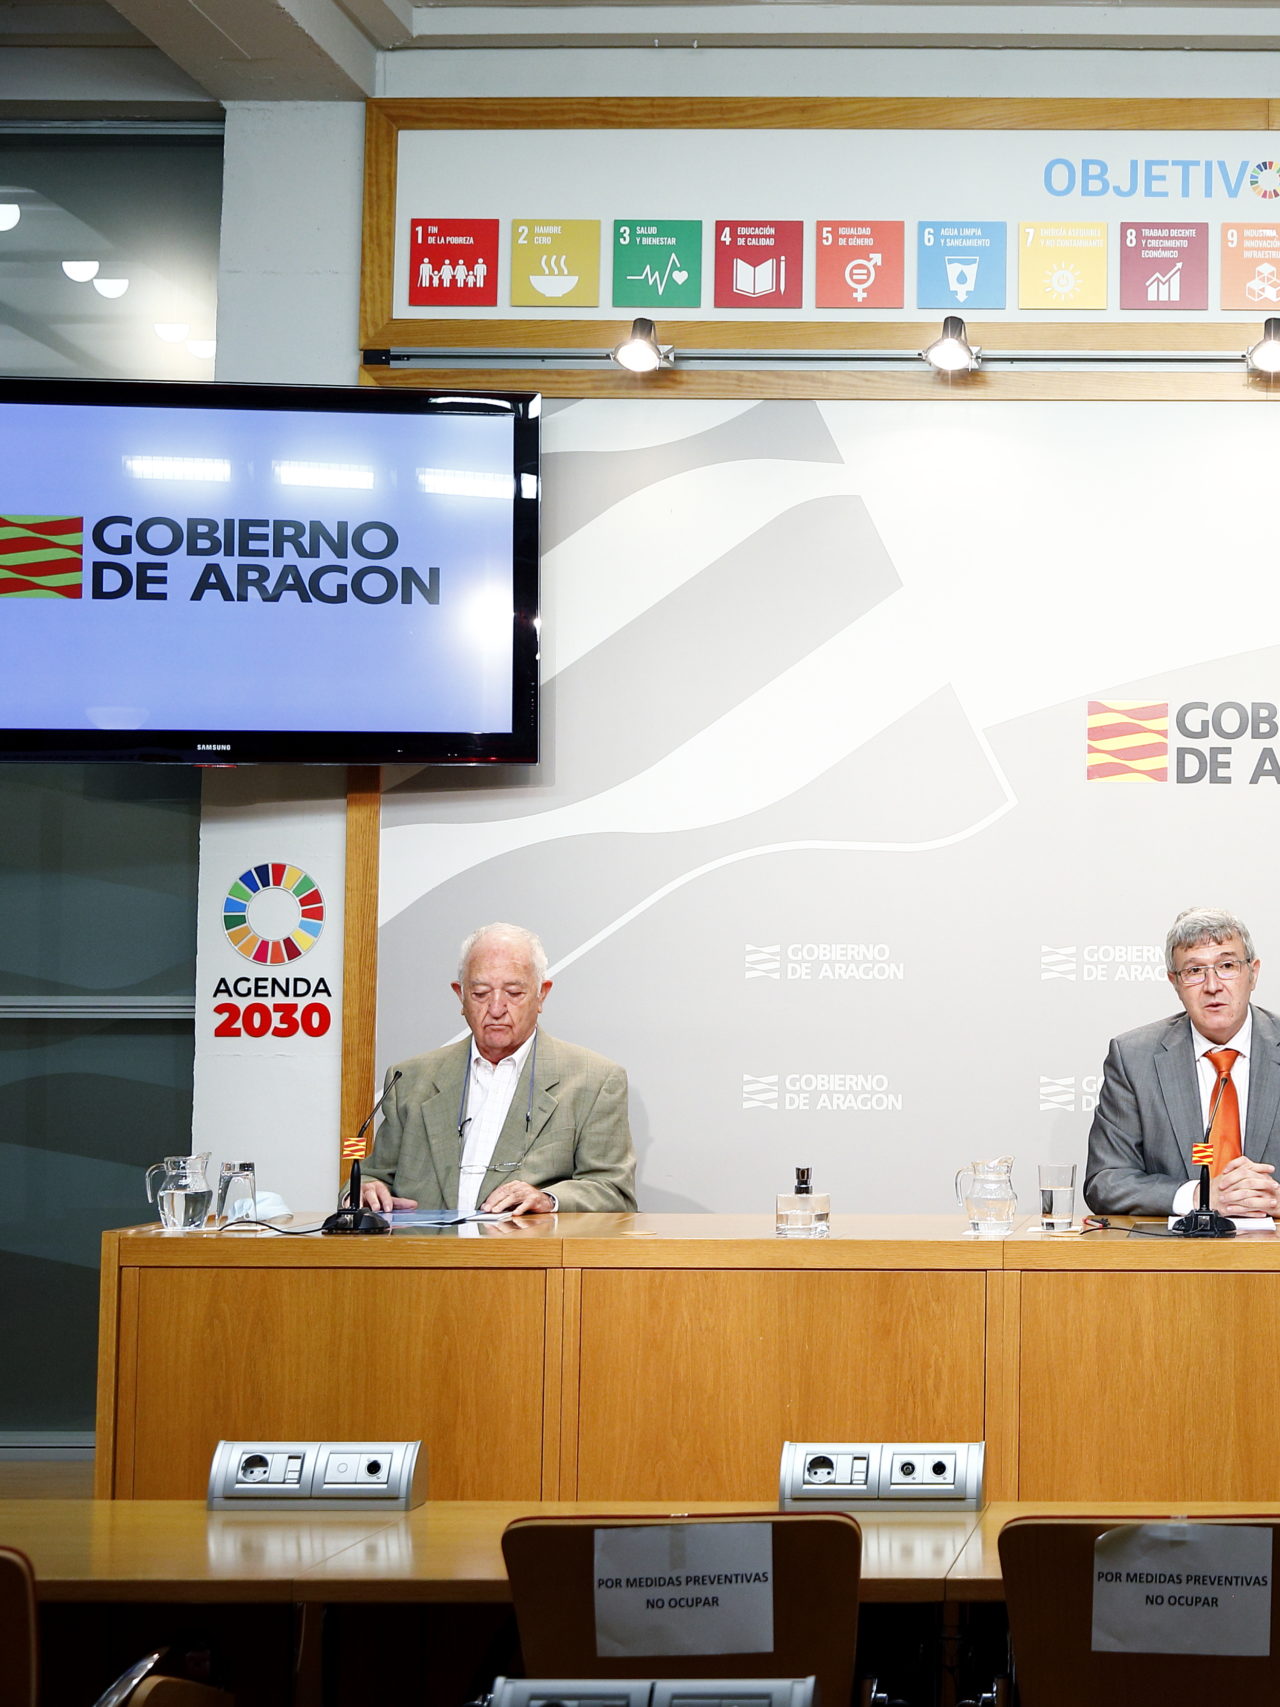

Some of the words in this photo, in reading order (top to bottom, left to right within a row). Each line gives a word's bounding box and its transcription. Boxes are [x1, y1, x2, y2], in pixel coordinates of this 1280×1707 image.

[416, 226, 423, 243] 1
[428, 226, 438, 234] FIN
[518, 226, 528, 244] 2
[534, 226, 561, 234] HAMBRE
[619, 226, 630, 244] 3
[636, 226, 657, 234] SALUD
[720, 227, 731, 245] 4
[738, 225, 775, 235] EDUCACIÓN
[822, 227, 832, 245] 5
[839, 227, 871, 235] IGUALDAD
[924, 228, 934, 246] 6
[941, 228, 958, 236] AGUA
[960, 228, 981, 236] LIMPIA
[1025, 228, 1035, 247] 7
[1126, 229, 1136, 247] 8
[1142, 229, 1168, 237] TRABAJO
[1170, 229, 1196, 237] DECENTE
[1227, 229, 1237, 247] 9
[437, 236, 445, 244] LA
[447, 236, 474, 244] POBREZA
[534, 236, 551, 244] CERO
[642, 237, 676, 245] BIENESTAR
[738, 238, 745, 246] DE
[747, 238, 774, 246] CALIDAD
[839, 238, 847, 246] DE
[848, 236, 873, 246] GÉNERO
[946, 239, 990, 247] SANEAMIENTO
[1147, 240, 1188, 248] CRECIMIENTO
[1141, 249, 1178, 258] ECONÓMICO
[91, 516, 399, 560] GOBIERNO
[92, 561, 168, 600] DE
[190, 562, 440, 605] ARAGON
[1176, 747, 1232, 784] DE
[787, 943, 890, 961] GOBIERNO
[1084, 945, 1166, 962] GOBIERN
[787, 963, 811, 979] DE
[818, 963, 904, 980] ARAGON
[1084, 965, 1107, 980] DE
[1115, 965, 1168, 981] ARAG
[213, 977, 332, 998] AGENDA
[213, 1002, 331, 1037] 2030
[785, 1074, 888, 1092] GOBIERNO
[785, 1094, 809, 1110] DE
[816, 1094, 902, 1110] ARAGON
[598, 1578, 622, 1589] POR
[626, 1576, 682, 1588] MEDIDAS
[686, 1572, 769, 1586] PREVENTIVAS
[1098, 1572, 1122, 1582] POR
[1126, 1573, 1182, 1584] MEDIDAS
[1186, 1575, 1268, 1586] PREVENTIVAS
[646, 1598, 665, 1609] NO
[668, 1596, 719, 1608] OCUPAR
[1146, 1595, 1164, 1605] NO
[1168, 1595, 1218, 1607] OCUPAR
